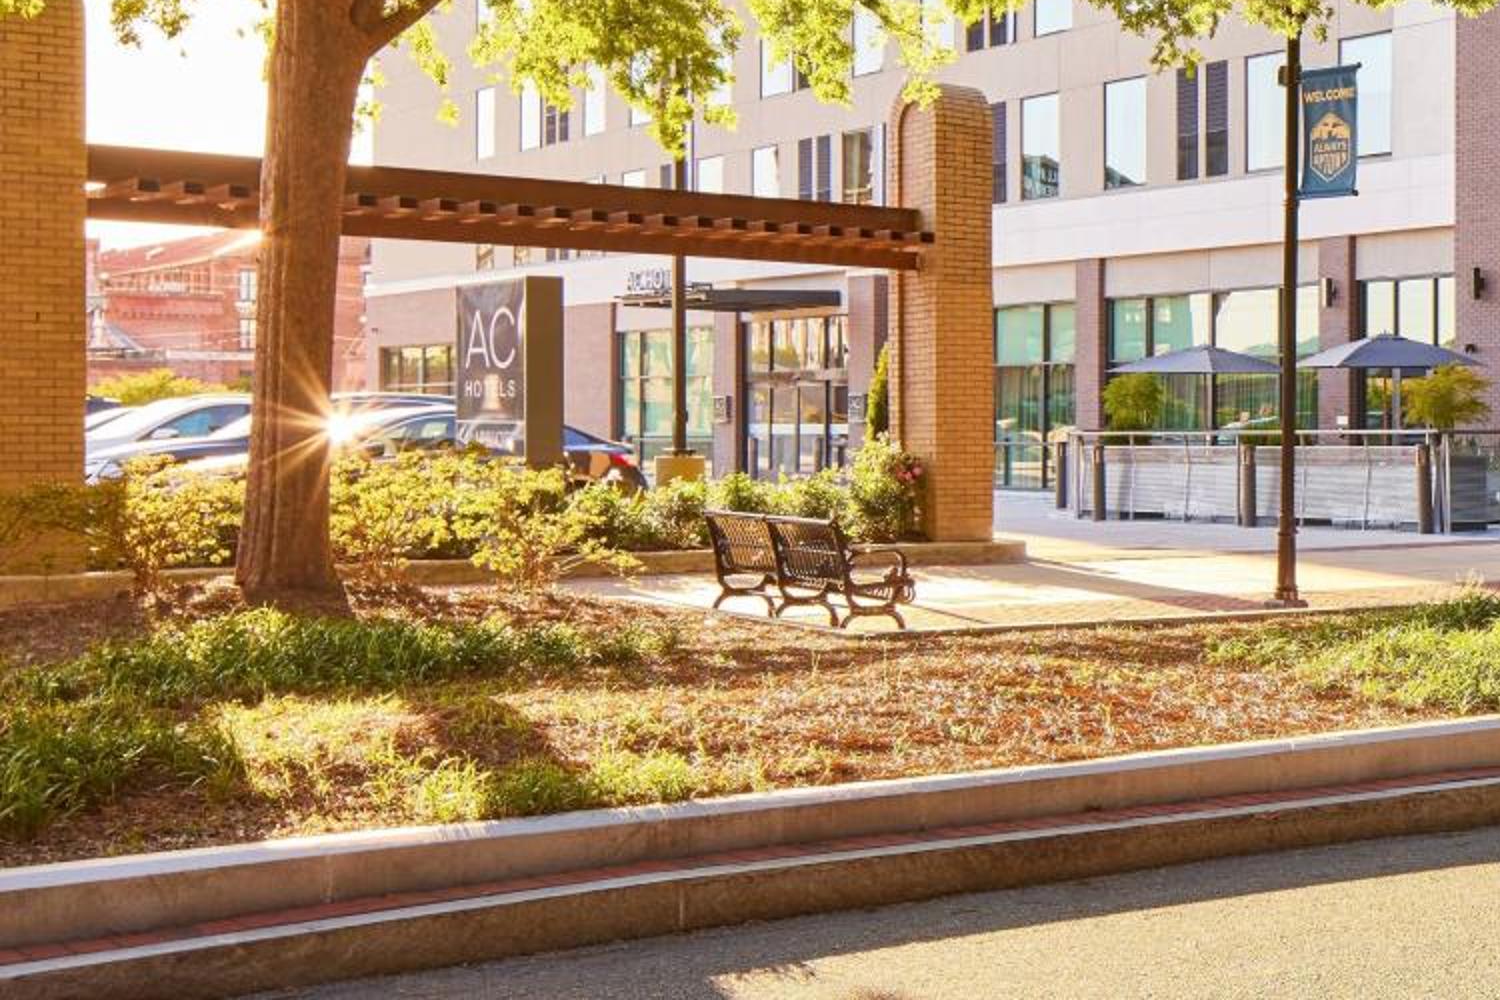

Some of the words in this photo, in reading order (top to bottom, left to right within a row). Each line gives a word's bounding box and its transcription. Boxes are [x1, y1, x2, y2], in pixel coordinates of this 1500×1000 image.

[1304, 87, 1355, 103] WELCOME
[465, 306, 516, 370] AC
[464, 379, 516, 398] HOLS
